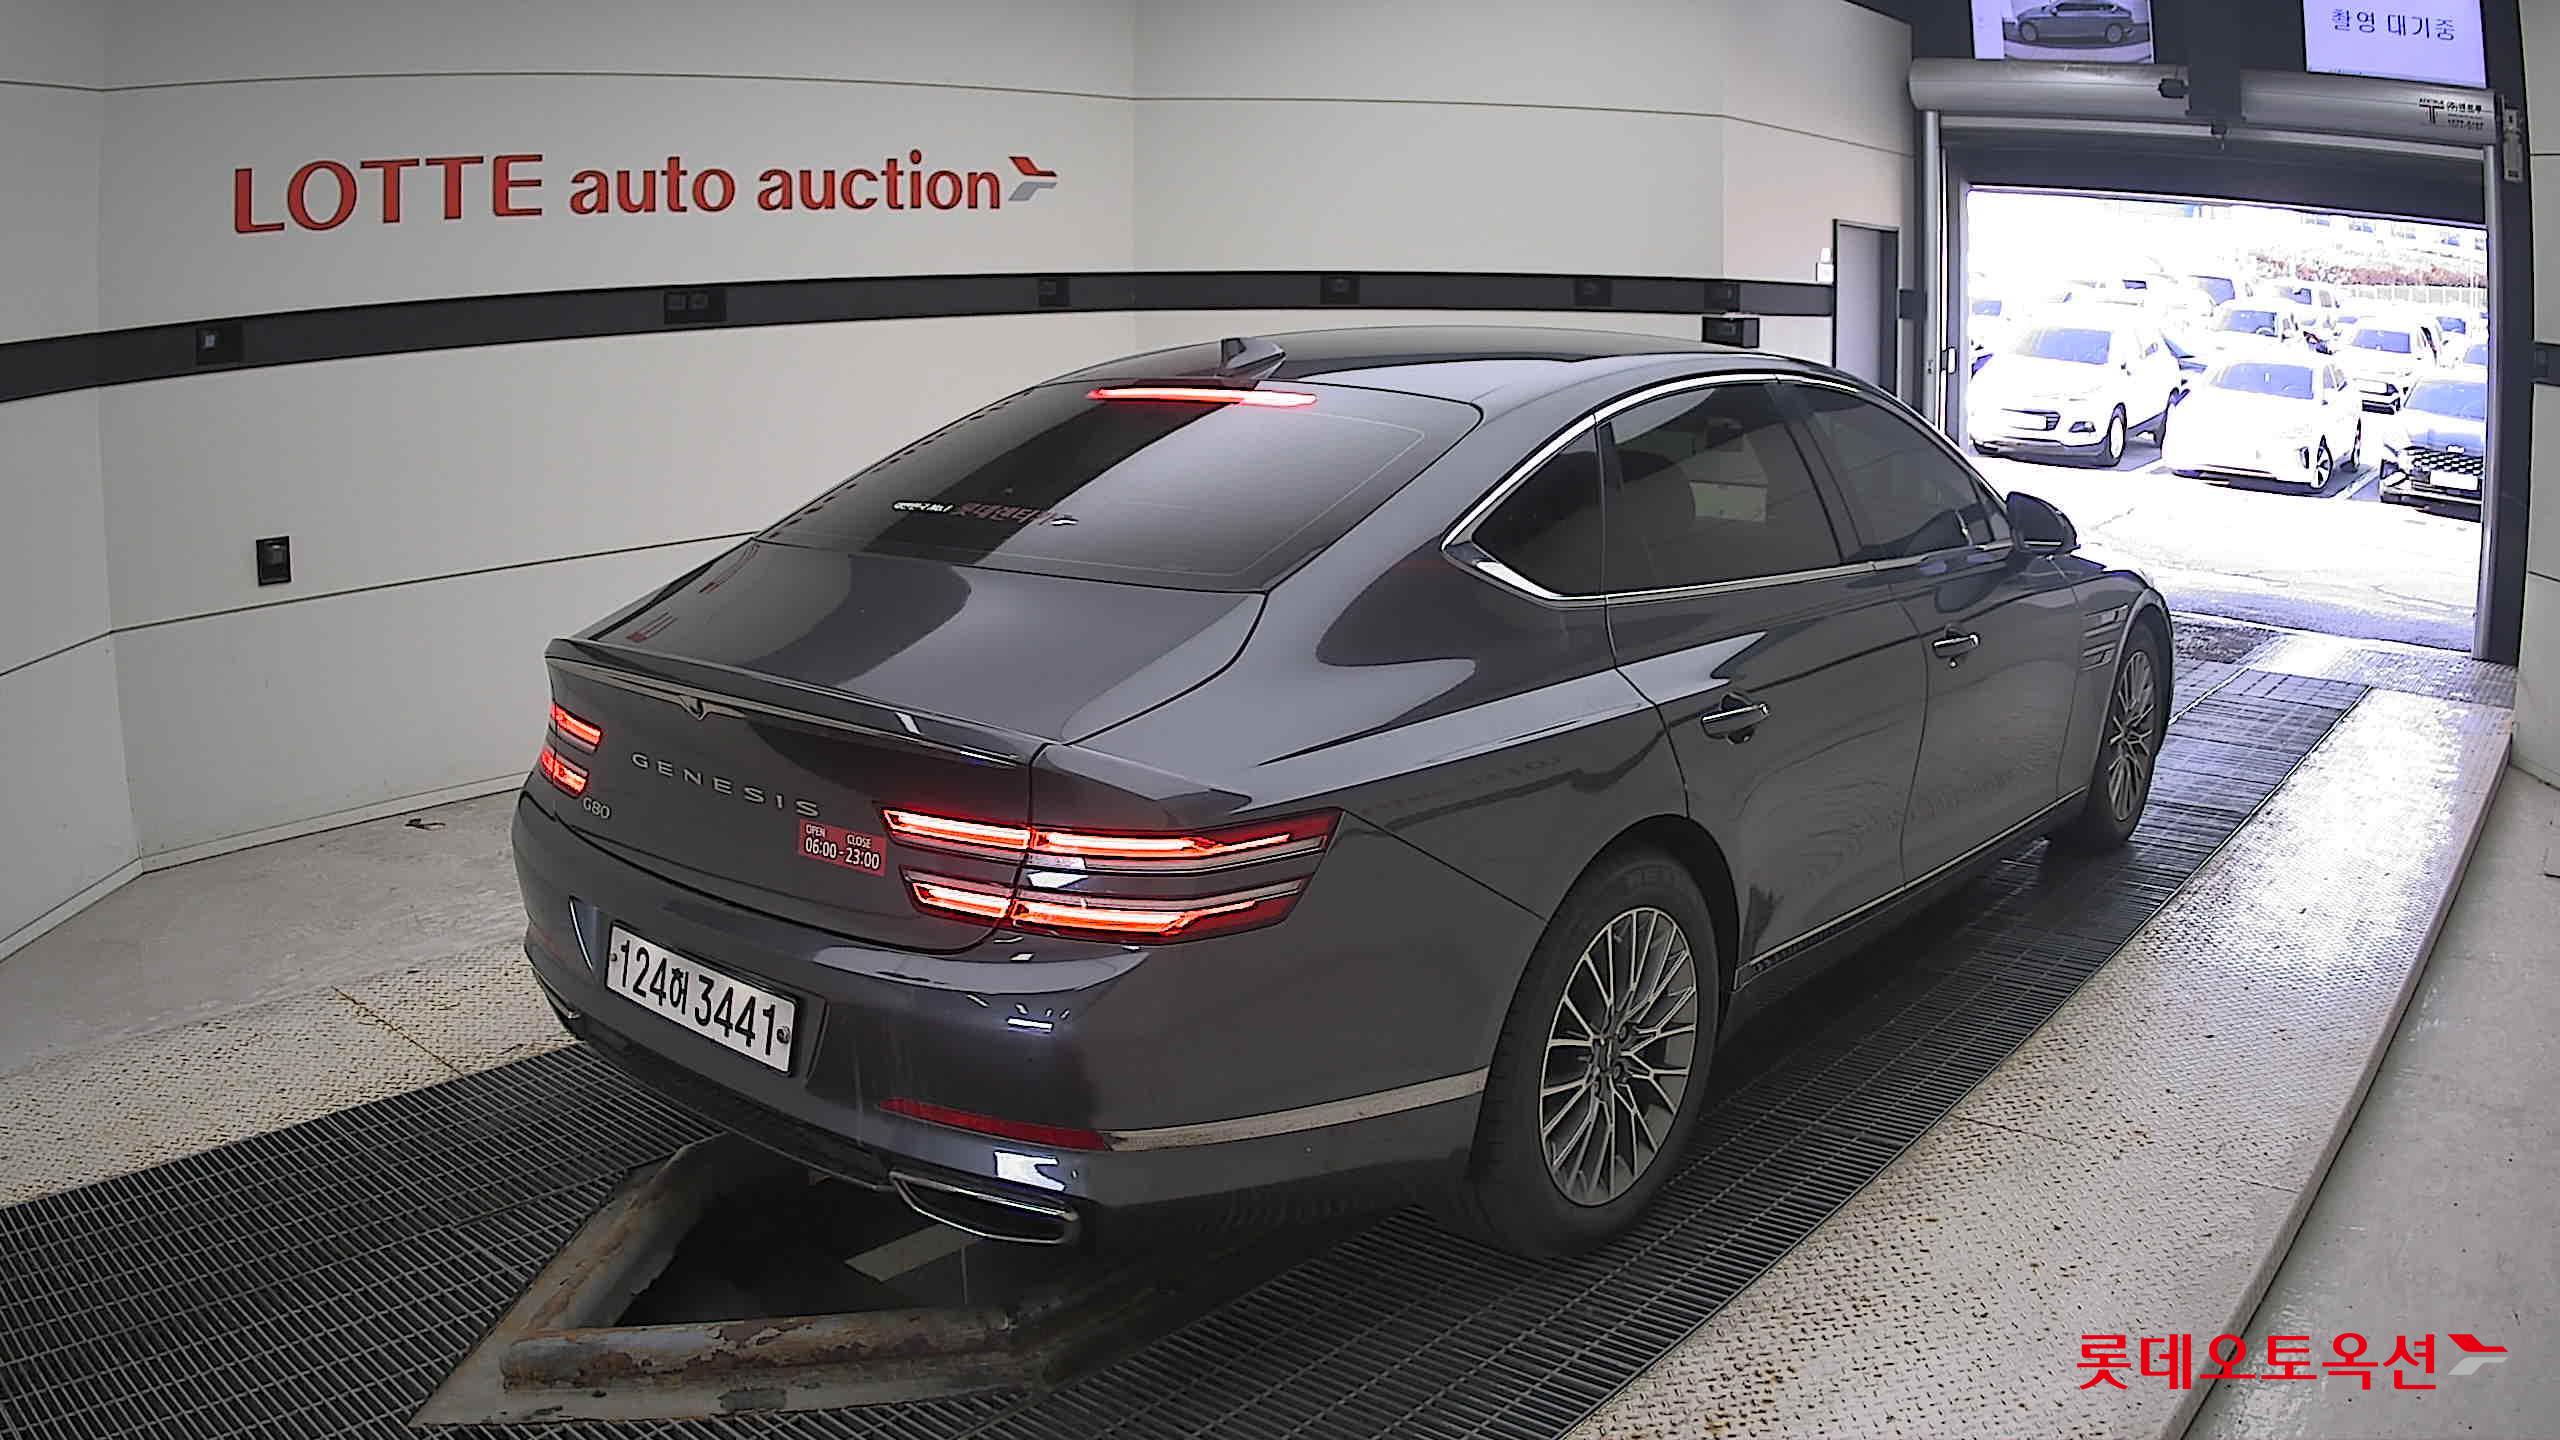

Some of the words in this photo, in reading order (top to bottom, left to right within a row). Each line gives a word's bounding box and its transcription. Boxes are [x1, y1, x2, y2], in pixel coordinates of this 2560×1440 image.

[2331, 9, 2375, 33] 촬영
[2387, 14, 2455, 41] 대기중
[234, 154, 543, 234] LOTTE
[570, 156, 736, 215] auto
[757, 149, 1001, 212] auction
[631, 752, 819, 818] GENESIS
[583, 796, 611, 819] G80
[805, 824, 826, 838] OPEN
[847, 834, 872, 849] CLOSE
